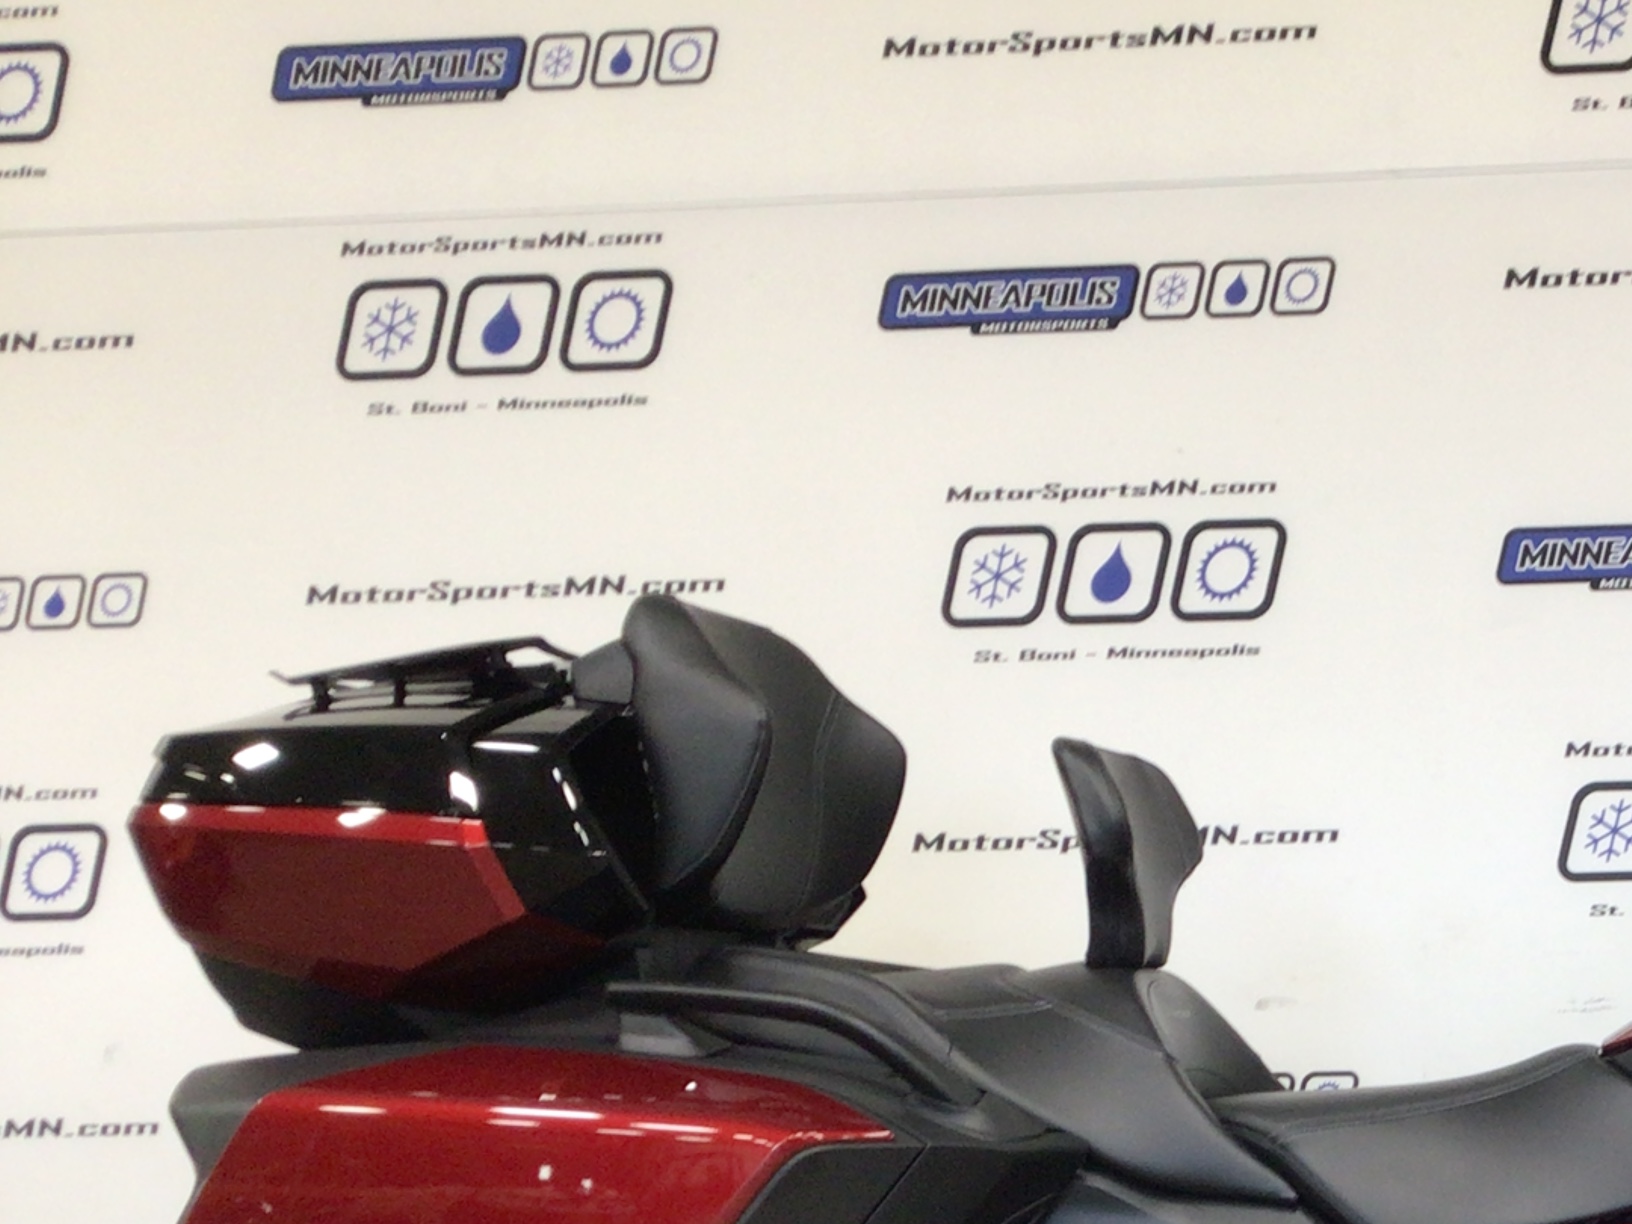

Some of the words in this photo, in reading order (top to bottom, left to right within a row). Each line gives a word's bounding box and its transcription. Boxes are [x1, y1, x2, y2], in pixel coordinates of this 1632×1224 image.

[882, 22, 1318, 59] MotorSportsMN.com
[289, 48, 505, 90] MINNEAPOLIS
[1572, 97, 1608, 112] St.
[340, 230, 663, 258] MotorSportsMN.com
[897, 277, 1119, 317] MINNEAPOLIS
[979, 317, 1111, 334] MOTORSPORTS
[367, 402, 399, 417] St.
[411, 400, 468, 415] Boni
[496, 393, 648, 411] Minneapolis
[945, 478, 1277, 503] MotorSportsMN.com
[973, 649, 1007, 664] St.
[1018, 648, 1077, 662] Boni
[1106, 643, 1261, 660] Minneapolis
[911, 823, 1341, 854] MotorSpN.com
[1589, 904, 1624, 917] St.
